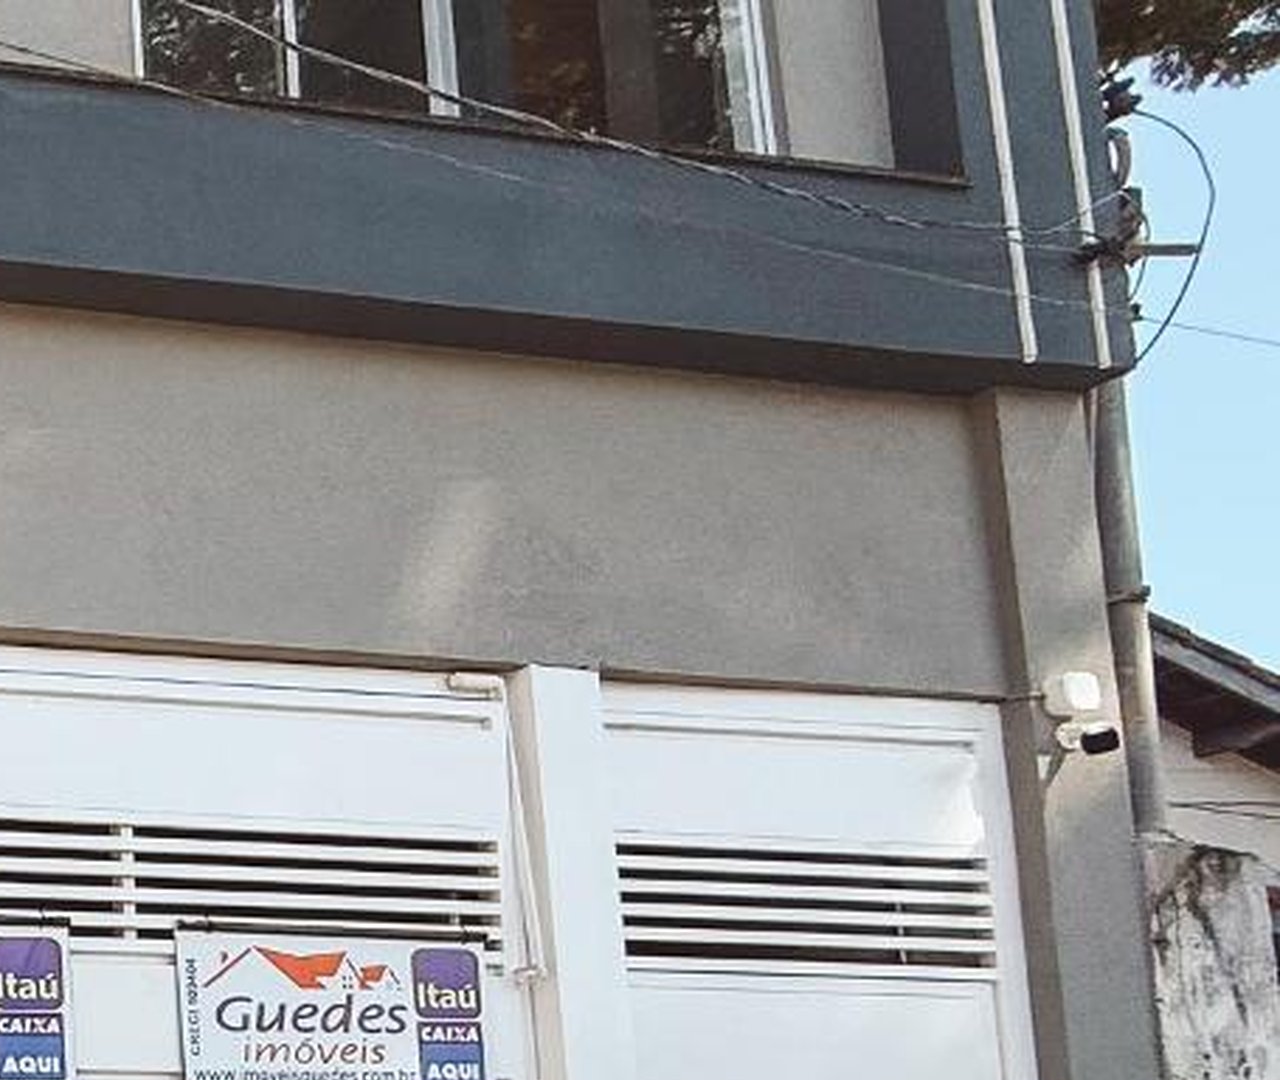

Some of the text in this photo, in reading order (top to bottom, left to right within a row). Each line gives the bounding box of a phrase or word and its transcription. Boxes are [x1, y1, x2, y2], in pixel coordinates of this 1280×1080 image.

[418, 983, 477, 1009] Itaú
[215, 993, 408, 1034] Guedes
[421, 1026, 480, 1043] CAIXA
[2, 1056, 61, 1073] AQUI
[243, 1038, 387, 1065] imóveis
